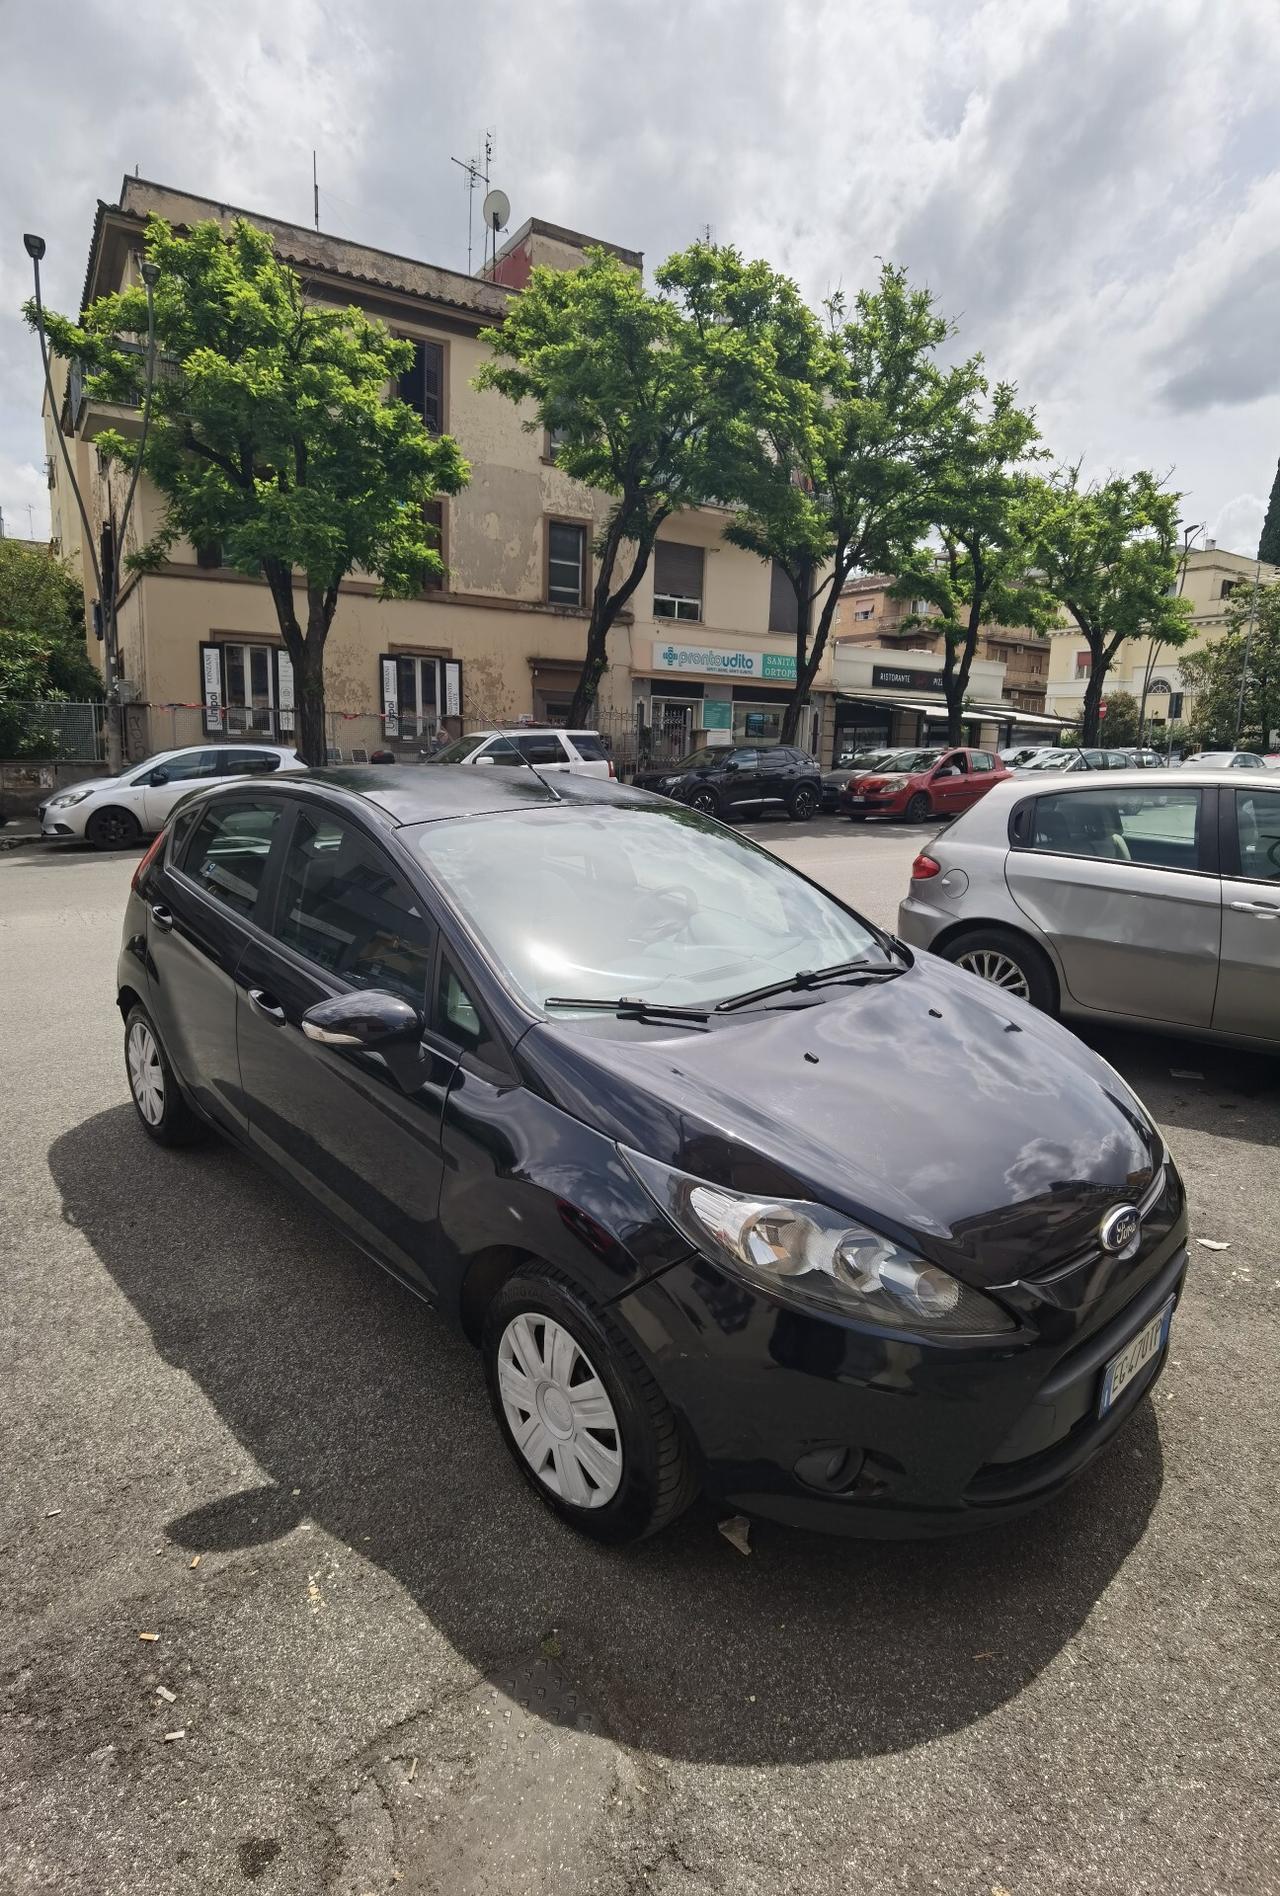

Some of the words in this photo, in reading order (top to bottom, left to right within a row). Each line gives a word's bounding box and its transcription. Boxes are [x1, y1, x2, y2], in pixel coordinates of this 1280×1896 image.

[678, 650, 754, 669] prontoudito
[767, 656, 796, 666] SANITA
[765, 668, 796, 679] ORTOPE
[880, 672, 911, 683] RISTORANTE
[206, 691, 221, 723] Unipol
[384, 700, 398, 730] Unpol
[1116, 1215, 1137, 1244] Ford
